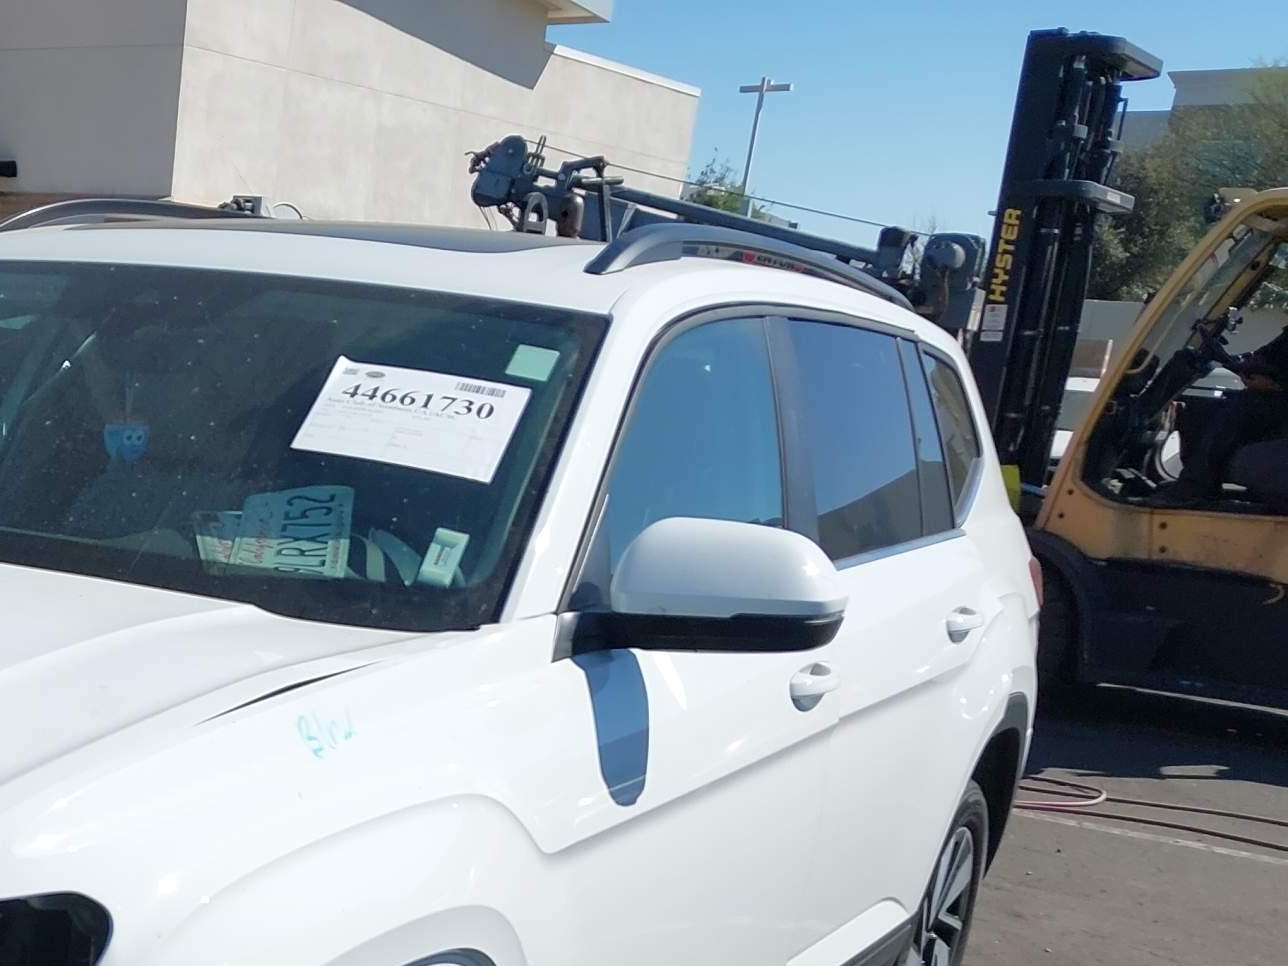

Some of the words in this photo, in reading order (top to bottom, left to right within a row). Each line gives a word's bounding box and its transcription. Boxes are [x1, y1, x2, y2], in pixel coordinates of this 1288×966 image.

[987, 208, 1022, 302] HYSTER
[342, 382, 496, 421] 44661730
[273, 494, 337, 575] 9LRX752
